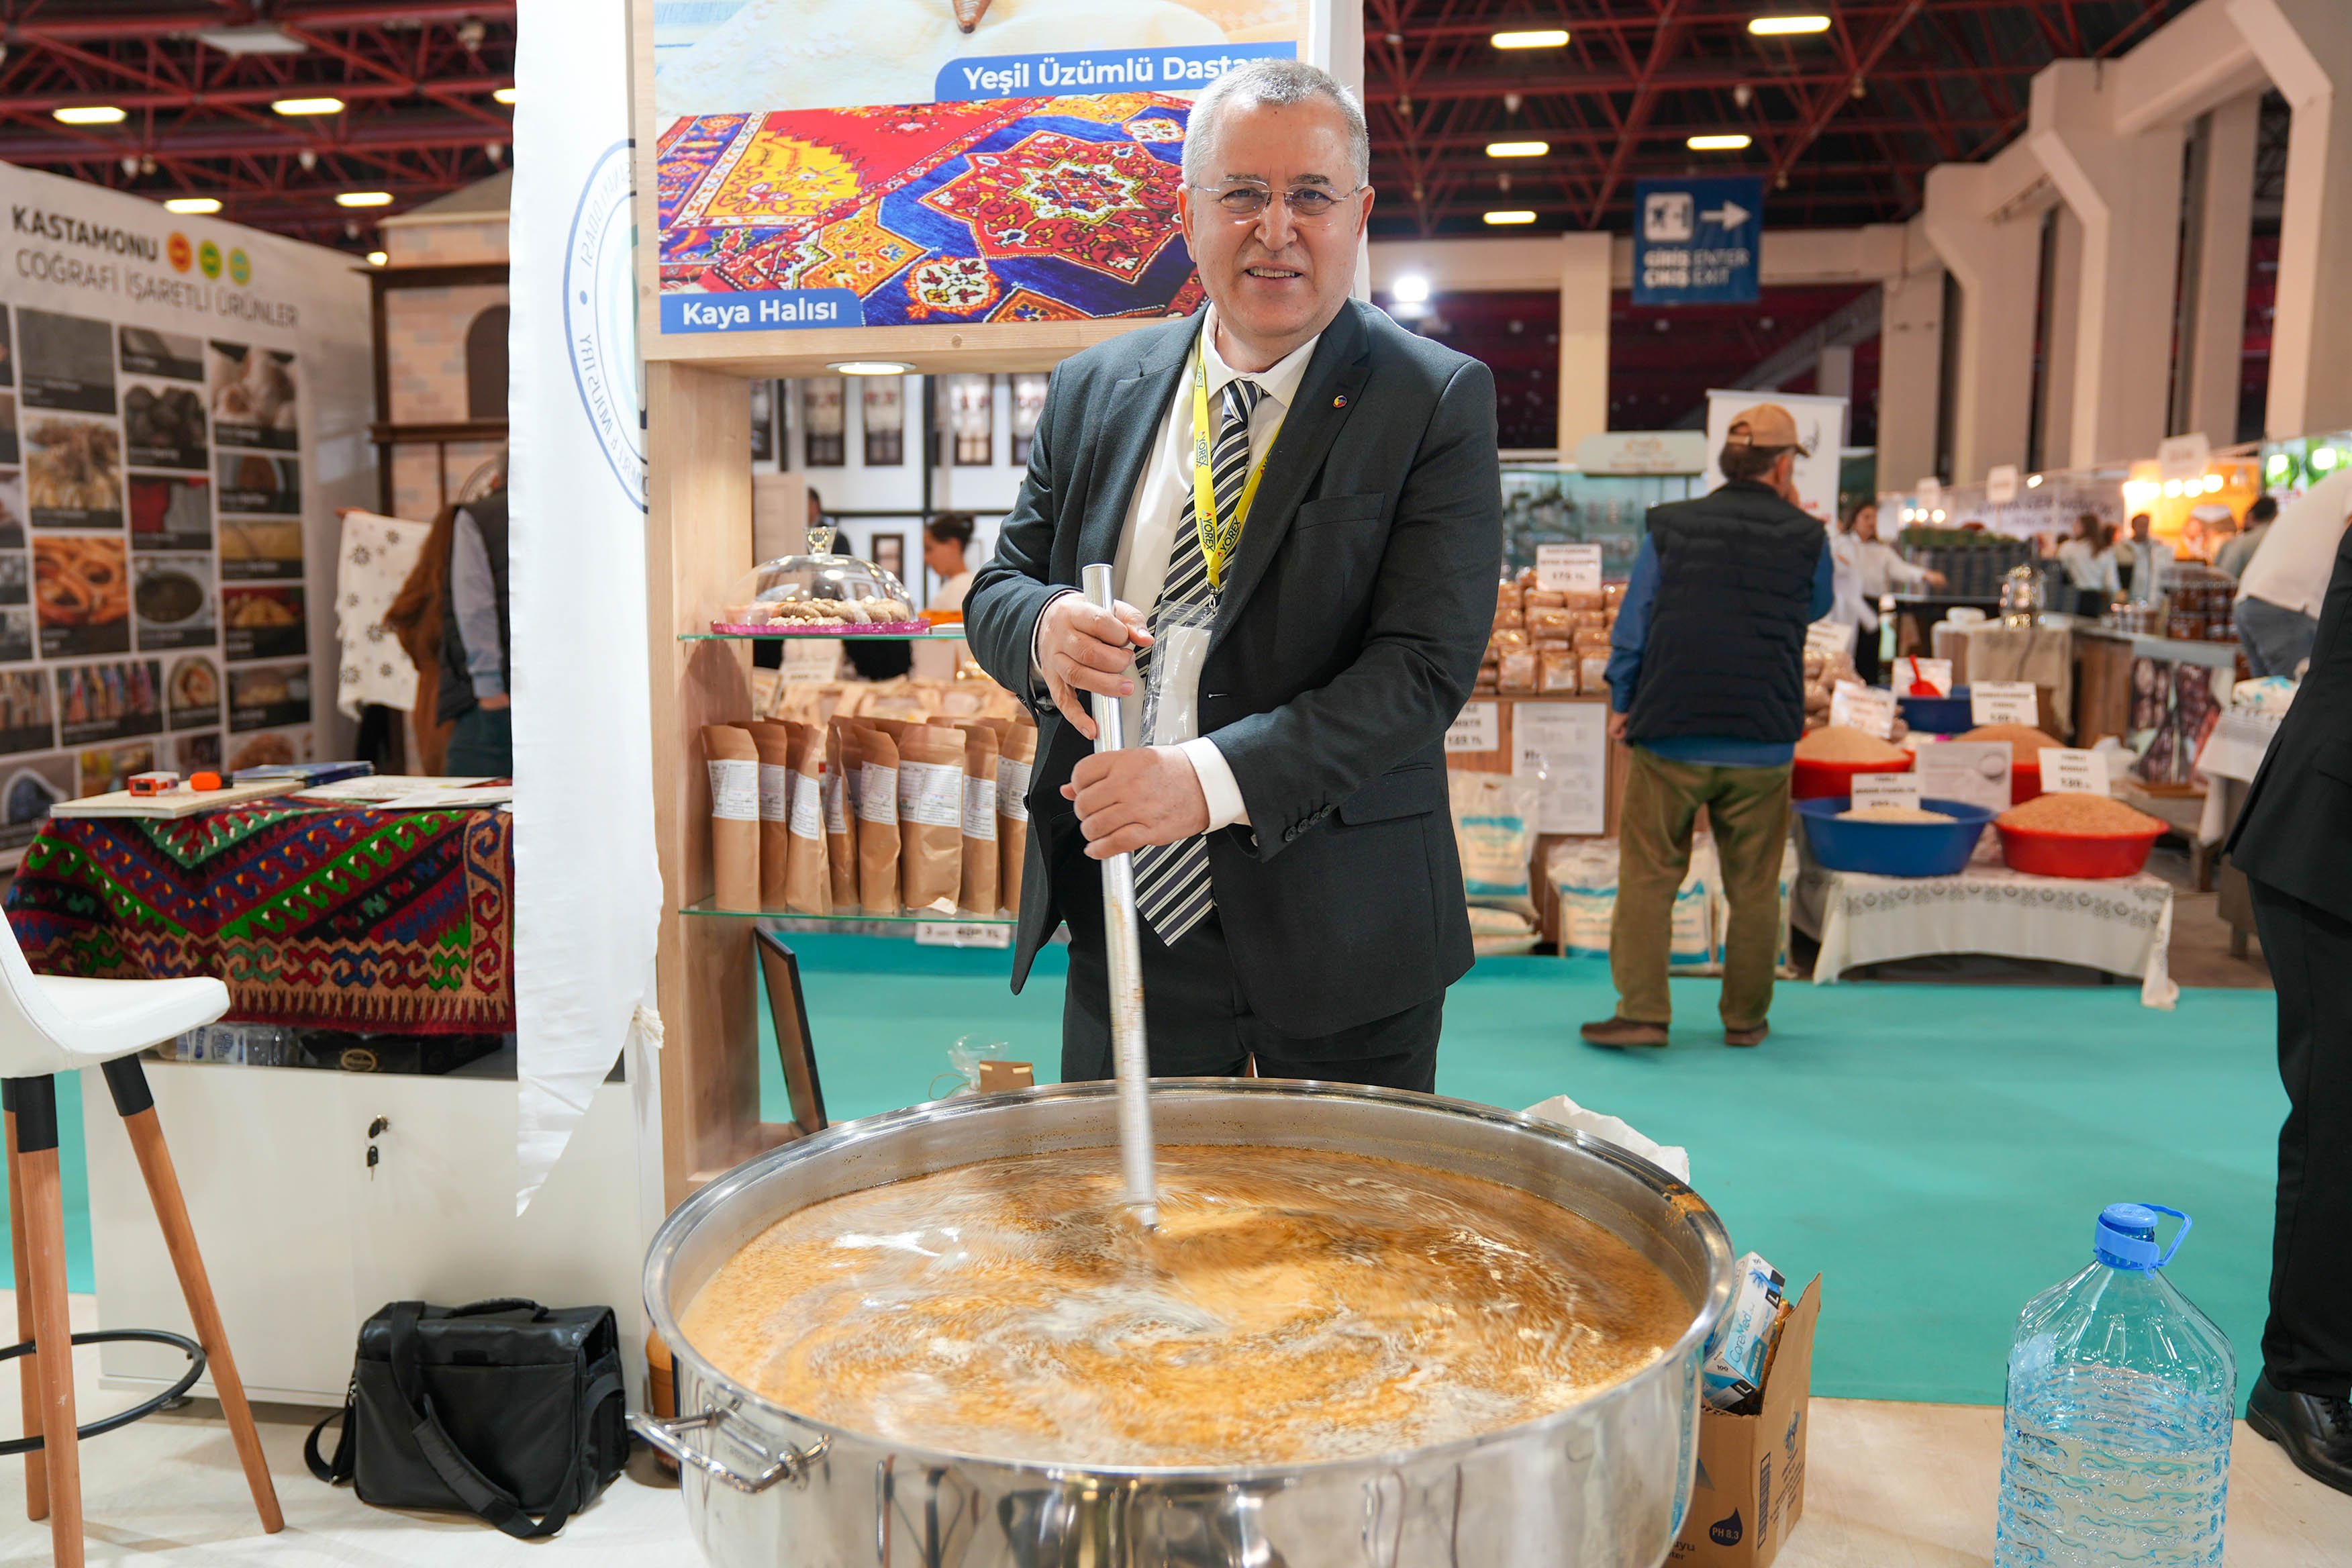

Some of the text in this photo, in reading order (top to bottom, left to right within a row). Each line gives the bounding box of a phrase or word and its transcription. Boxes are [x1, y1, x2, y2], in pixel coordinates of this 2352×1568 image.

[963, 62, 1029, 95] Yeşil
[1038, 58, 1154, 87] Üzümlü
[12, 204, 158, 262] KASTAMONU
[683, 297, 837, 330] Kaya Halısı
[1729, 1310, 1753, 1364] CoreMed
[1716, 1364, 1729, 1373] 100
[1736, 1382, 1752, 1395] L
[1712, 1526, 1740, 1540] PH 8.3
